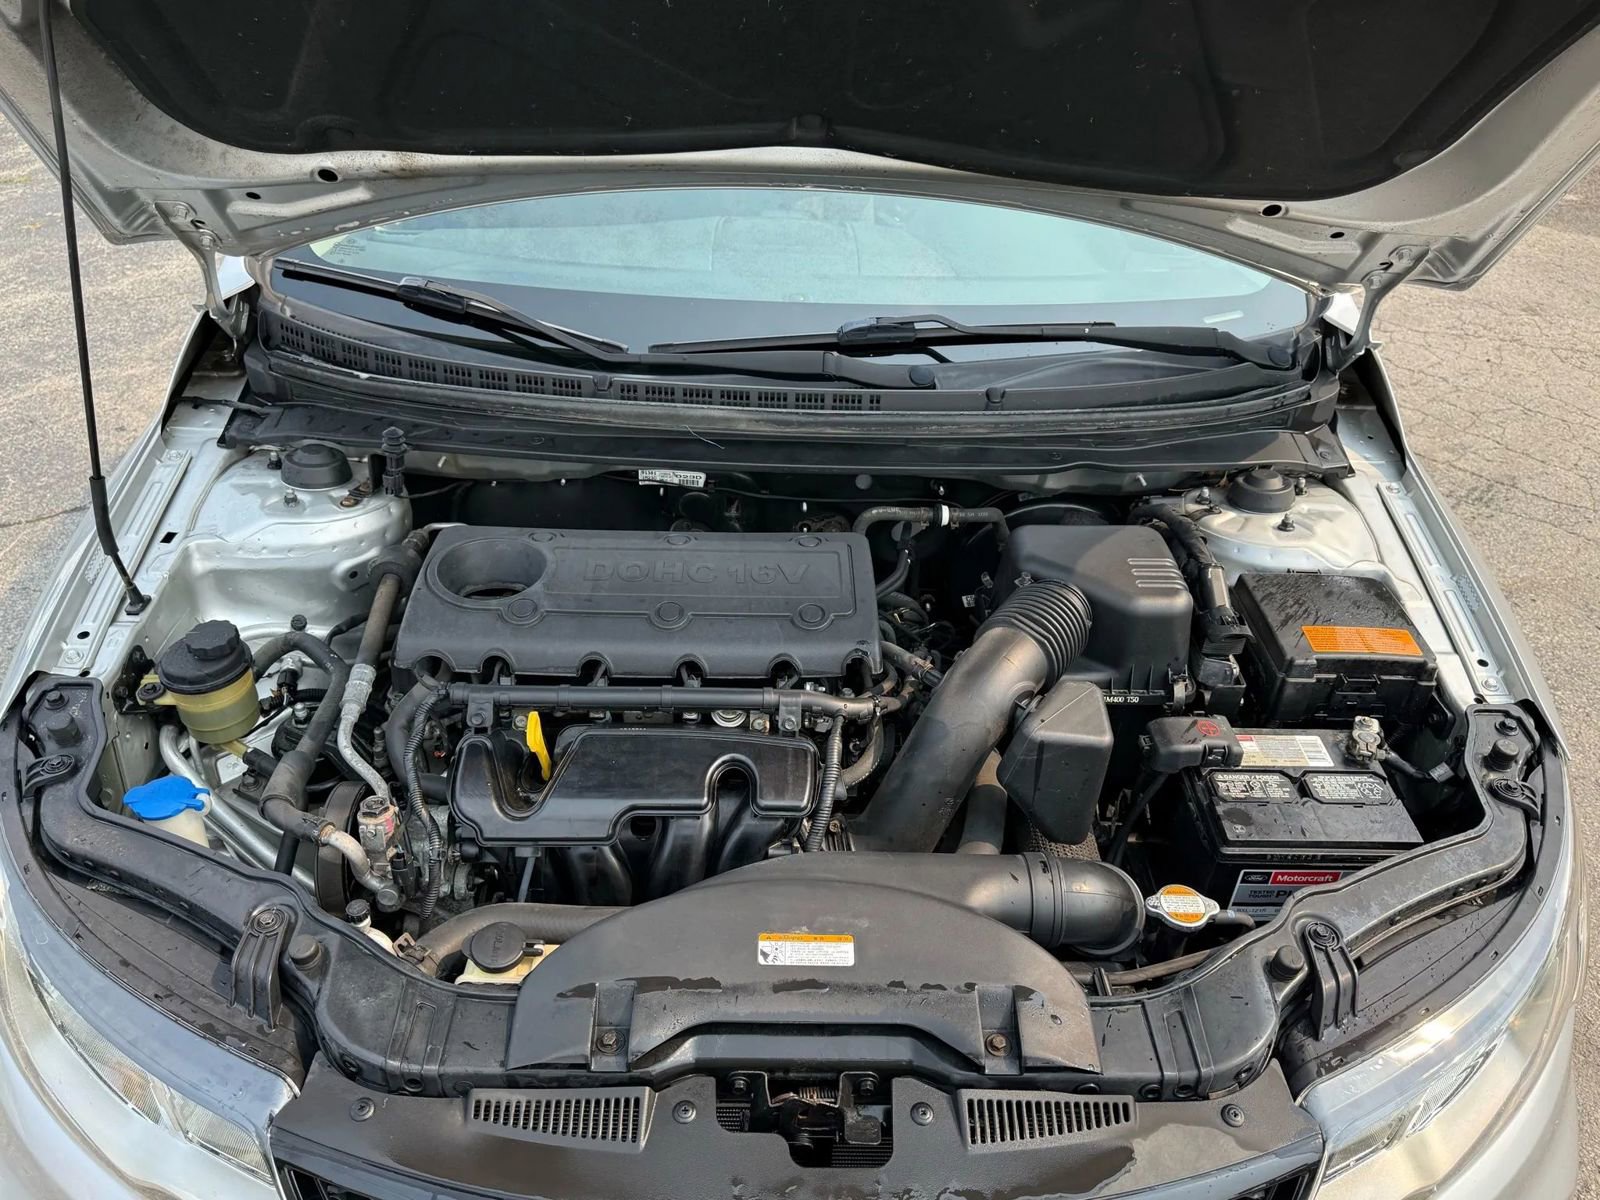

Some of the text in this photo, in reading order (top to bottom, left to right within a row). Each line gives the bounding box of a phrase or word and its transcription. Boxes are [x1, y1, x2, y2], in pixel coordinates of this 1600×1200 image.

[583, 559, 810, 585] DOHC 16V
[1276, 874, 1334, 882] Motorcraft
